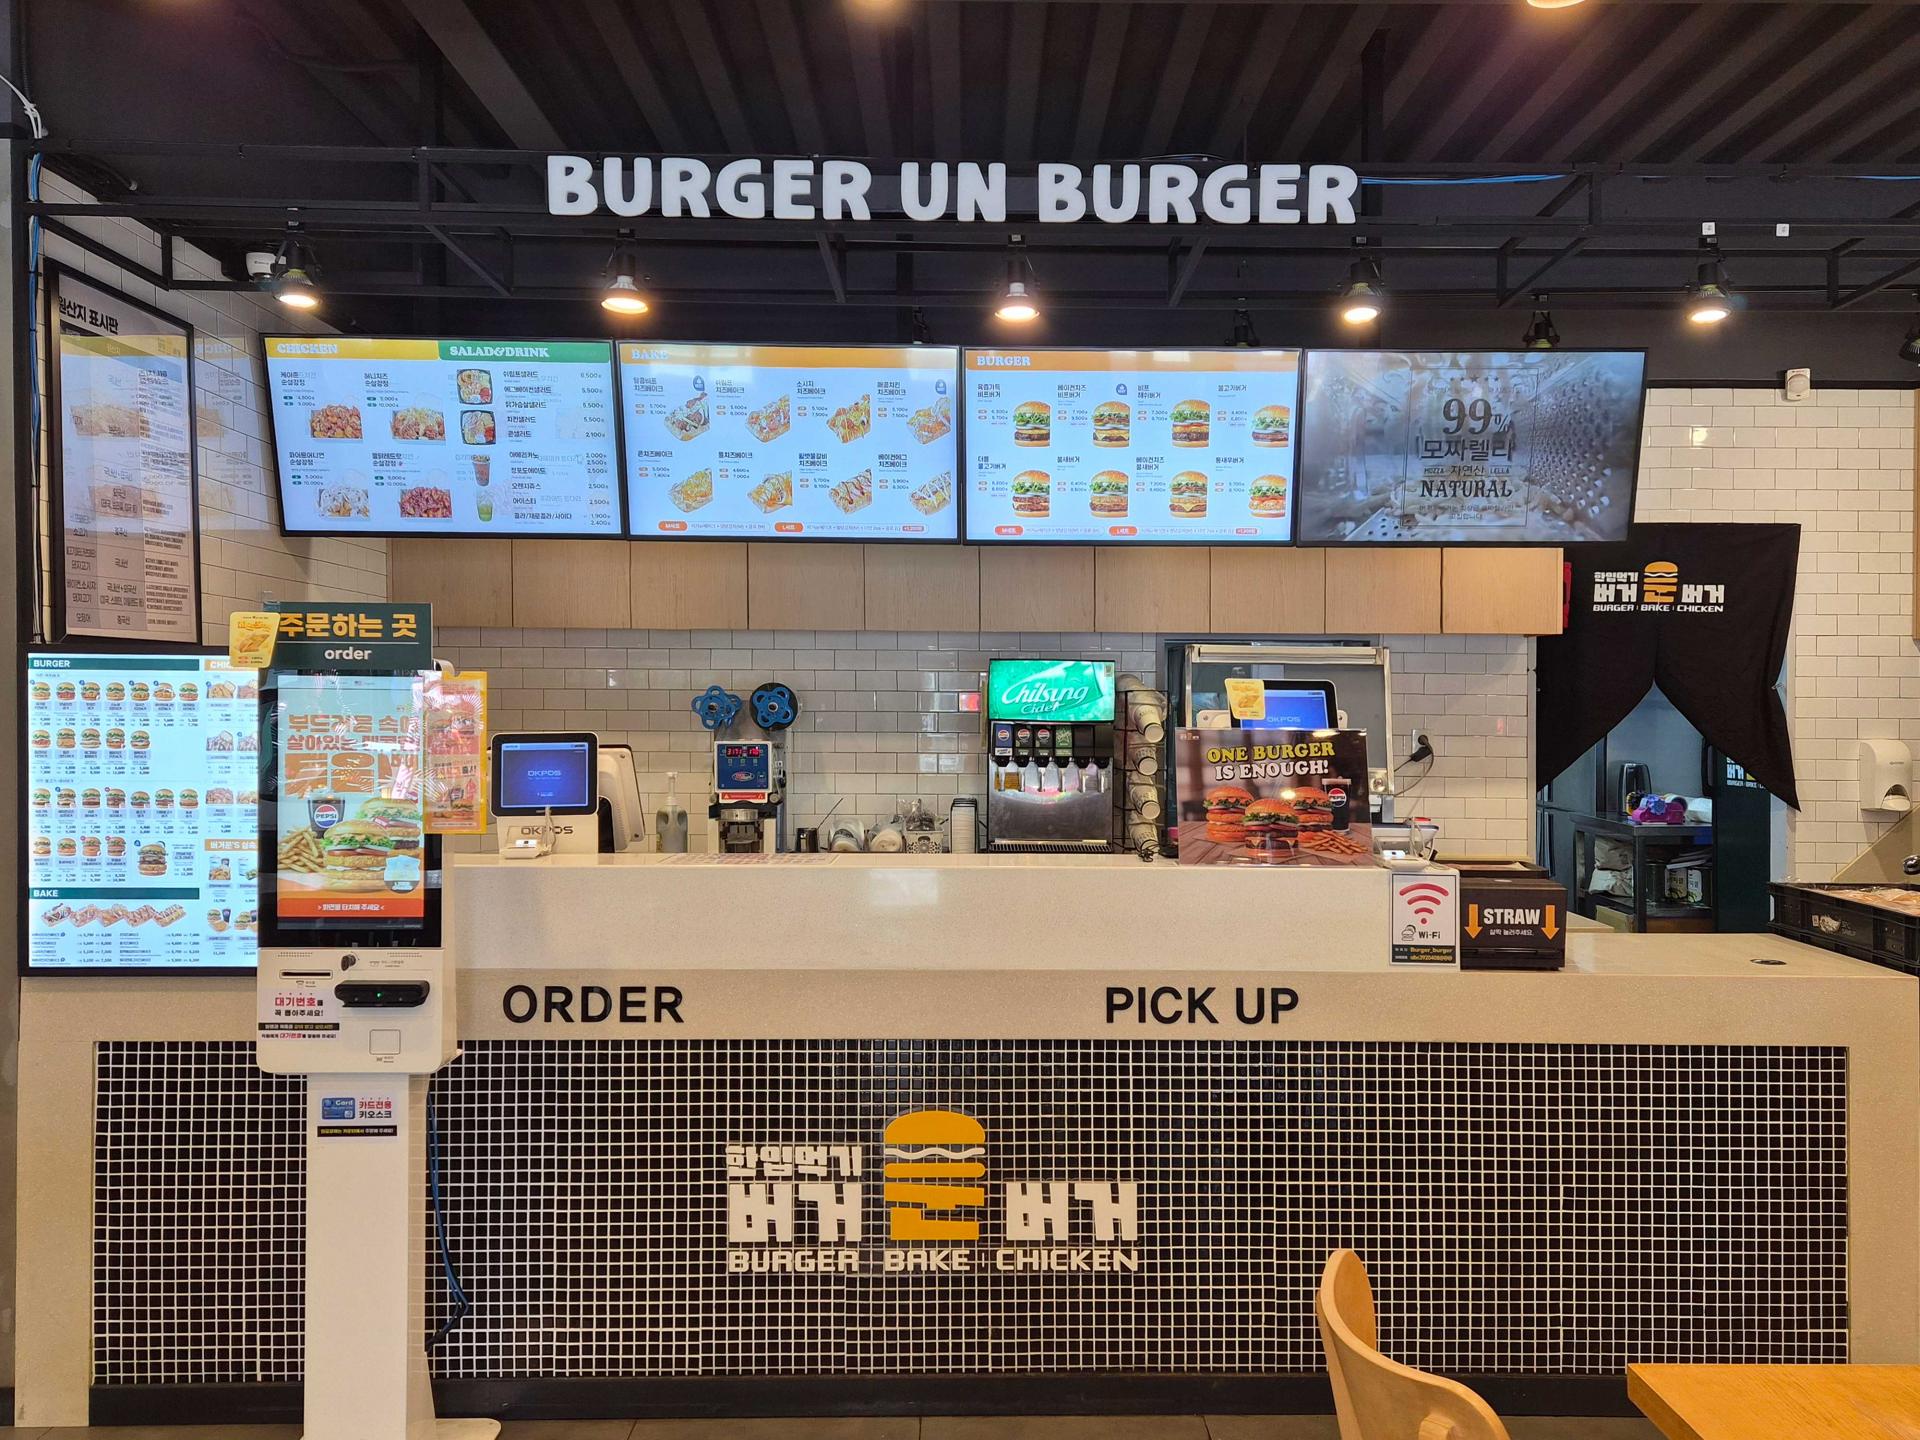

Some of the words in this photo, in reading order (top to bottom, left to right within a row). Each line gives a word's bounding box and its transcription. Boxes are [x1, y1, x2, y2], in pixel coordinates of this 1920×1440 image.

[546, 154, 873, 222] BURGER
[900, 161, 1007, 223] UN
[1037, 163, 1359, 226] BURGER
[89, 309, 118, 335] 표시판
[450, 346, 550, 358] SALAD&DRINK
[976, 355, 1031, 367] BURGER
[1442, 398, 1512, 434] 99%
[1449, 465, 1484, 476] 자연산
[1420, 480, 1513, 498] NATURAL
[1594, 571, 1639, 582] 한입먹기
[1593, 584, 1638, 602] 버거
[1681, 584, 1725, 603] 버거
[1592, 604, 1634, 612] BURGER
[1640, 604, 1670, 612] BAKE
[1676, 604, 1724, 613] CHICKEN
[279, 613, 383, 638] 주문하는
[392, 614, 417, 638] 곳
[324, 647, 372, 661] order
[33, 660, 71, 668] BURGER
[1002, 682, 1089, 704] Chilsung
[287, 735, 357, 751] 살아있는
[1207, 748, 1248, 763] ONE
[1253, 741, 1336, 761] BURGER
[1215, 766, 1236, 780] IS
[1240, 760, 1330, 779] ENOUGH!
[33, 890, 58, 898] BAKE
[1484, 908, 1540, 925] STRAW
[1418, 931, 1441, 939] Wi-Fi
[274, 996, 324, 1007] 대기번호를
[503, 985, 683, 1023] ORDER
[1106, 987, 1218, 1023] PICK
[1236, 987, 1298, 1023] UP
[359, 1100, 392, 1109] 카드전용
[359, 1111, 392, 1119] 키오스크
[725, 1145, 863, 1177] 한입먹기
[728, 1183, 863, 1242] 버거
[1006, 1182, 1138, 1241] 버거
[728, 1250, 860, 1273] BURGER
[884, 1249, 970, 1272] BAKE
[996, 1249, 1138, 1272] CHICKEN
